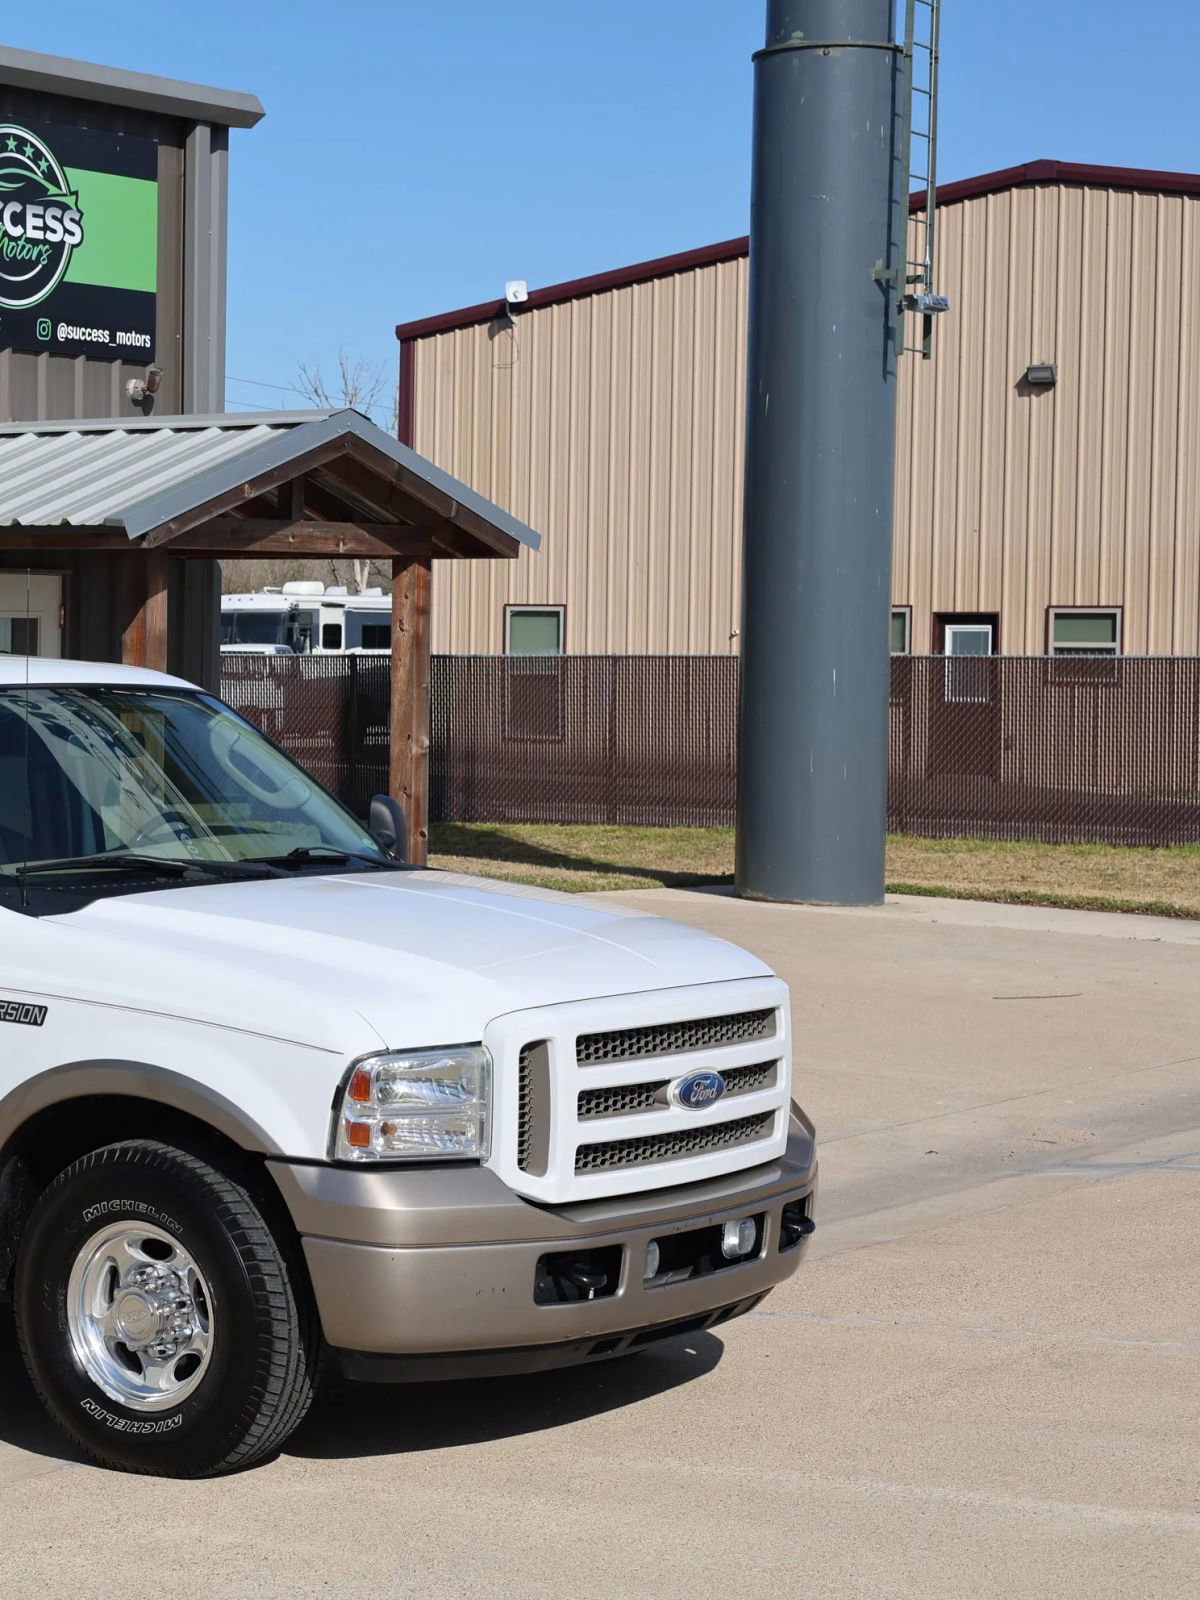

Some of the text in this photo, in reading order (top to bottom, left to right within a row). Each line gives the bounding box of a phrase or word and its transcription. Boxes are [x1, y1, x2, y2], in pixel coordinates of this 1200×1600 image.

[57, 323, 151, 348] @success_motors
[690, 1079, 718, 1102] Ford
[82, 1199, 184, 1235] MICHELIN
[80, 1397, 183, 1434] MICHELIN
